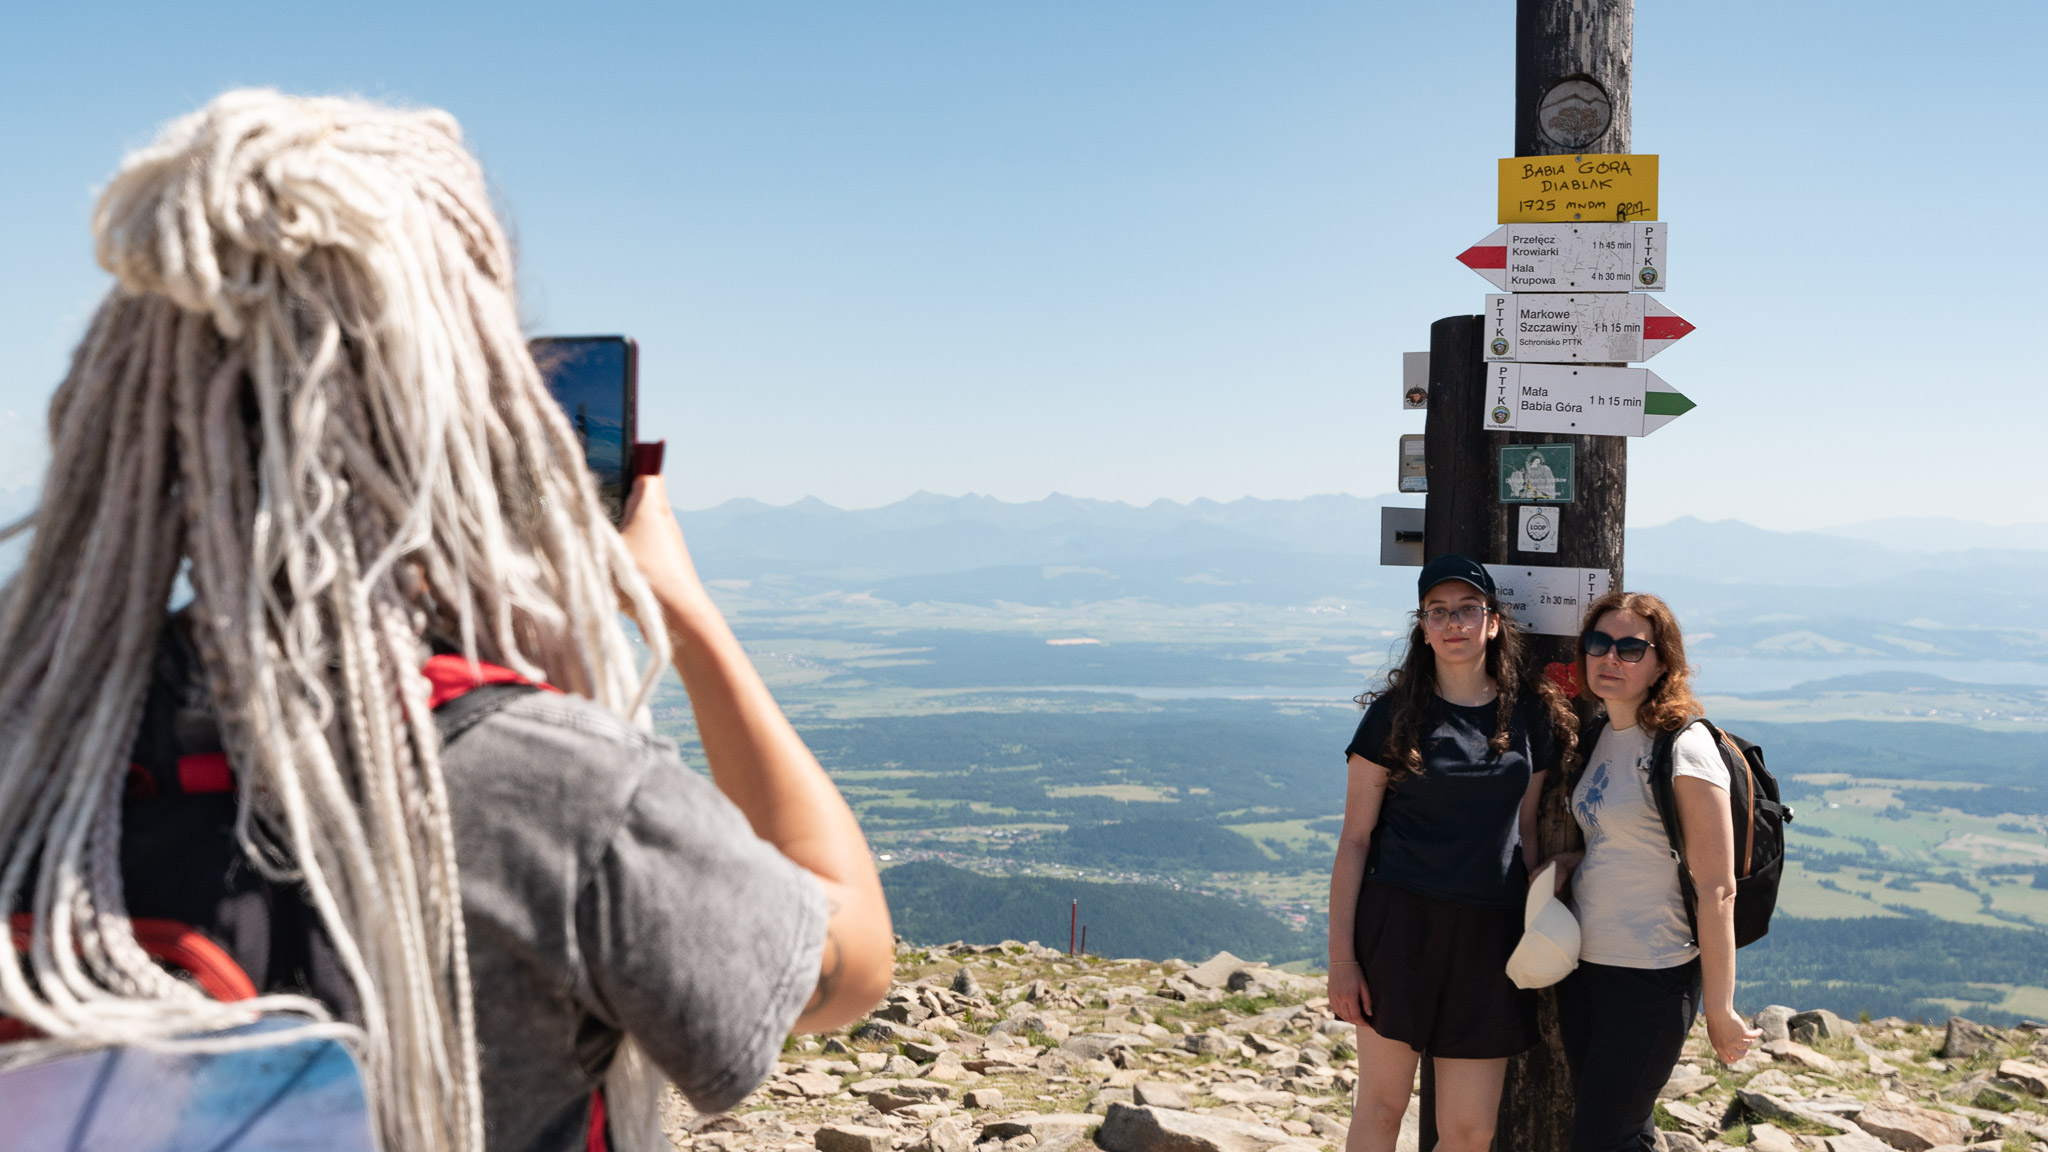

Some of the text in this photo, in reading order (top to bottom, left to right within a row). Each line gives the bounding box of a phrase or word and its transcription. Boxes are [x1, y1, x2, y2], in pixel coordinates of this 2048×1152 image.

[1521, 163, 1566, 179] BABIA
[1519, 199, 1556, 212] 1725
[1512, 235, 1555, 246] Przełęcz
[1599, 241, 1605, 249] h
[1606, 241, 1616, 250] 45
[1617, 241, 1632, 250] min
[1512, 247, 1559, 256] Krowiarki
[1512, 264, 1534, 273] Hala
[1511, 276, 1556, 286] Krupowa
[1591, 272, 1631, 281] 4 h 30 min
[1520, 309, 1570, 319] Markowe
[1519, 323, 1578, 334] Szczawiny
[1594, 323, 1641, 333] 1 h 15 min
[1519, 338, 1583, 346] Schronisko PTTK
[1521, 386, 1548, 397] Mała
[1521, 400, 1583, 413] Babia Góra
[1598, 396, 1604, 406] h
[1608, 396, 1620, 406] 15
[1622, 397, 1642, 407] min
[1495, 585, 1514, 596] nica
[1540, 595, 1577, 606] 2 h 30 min
